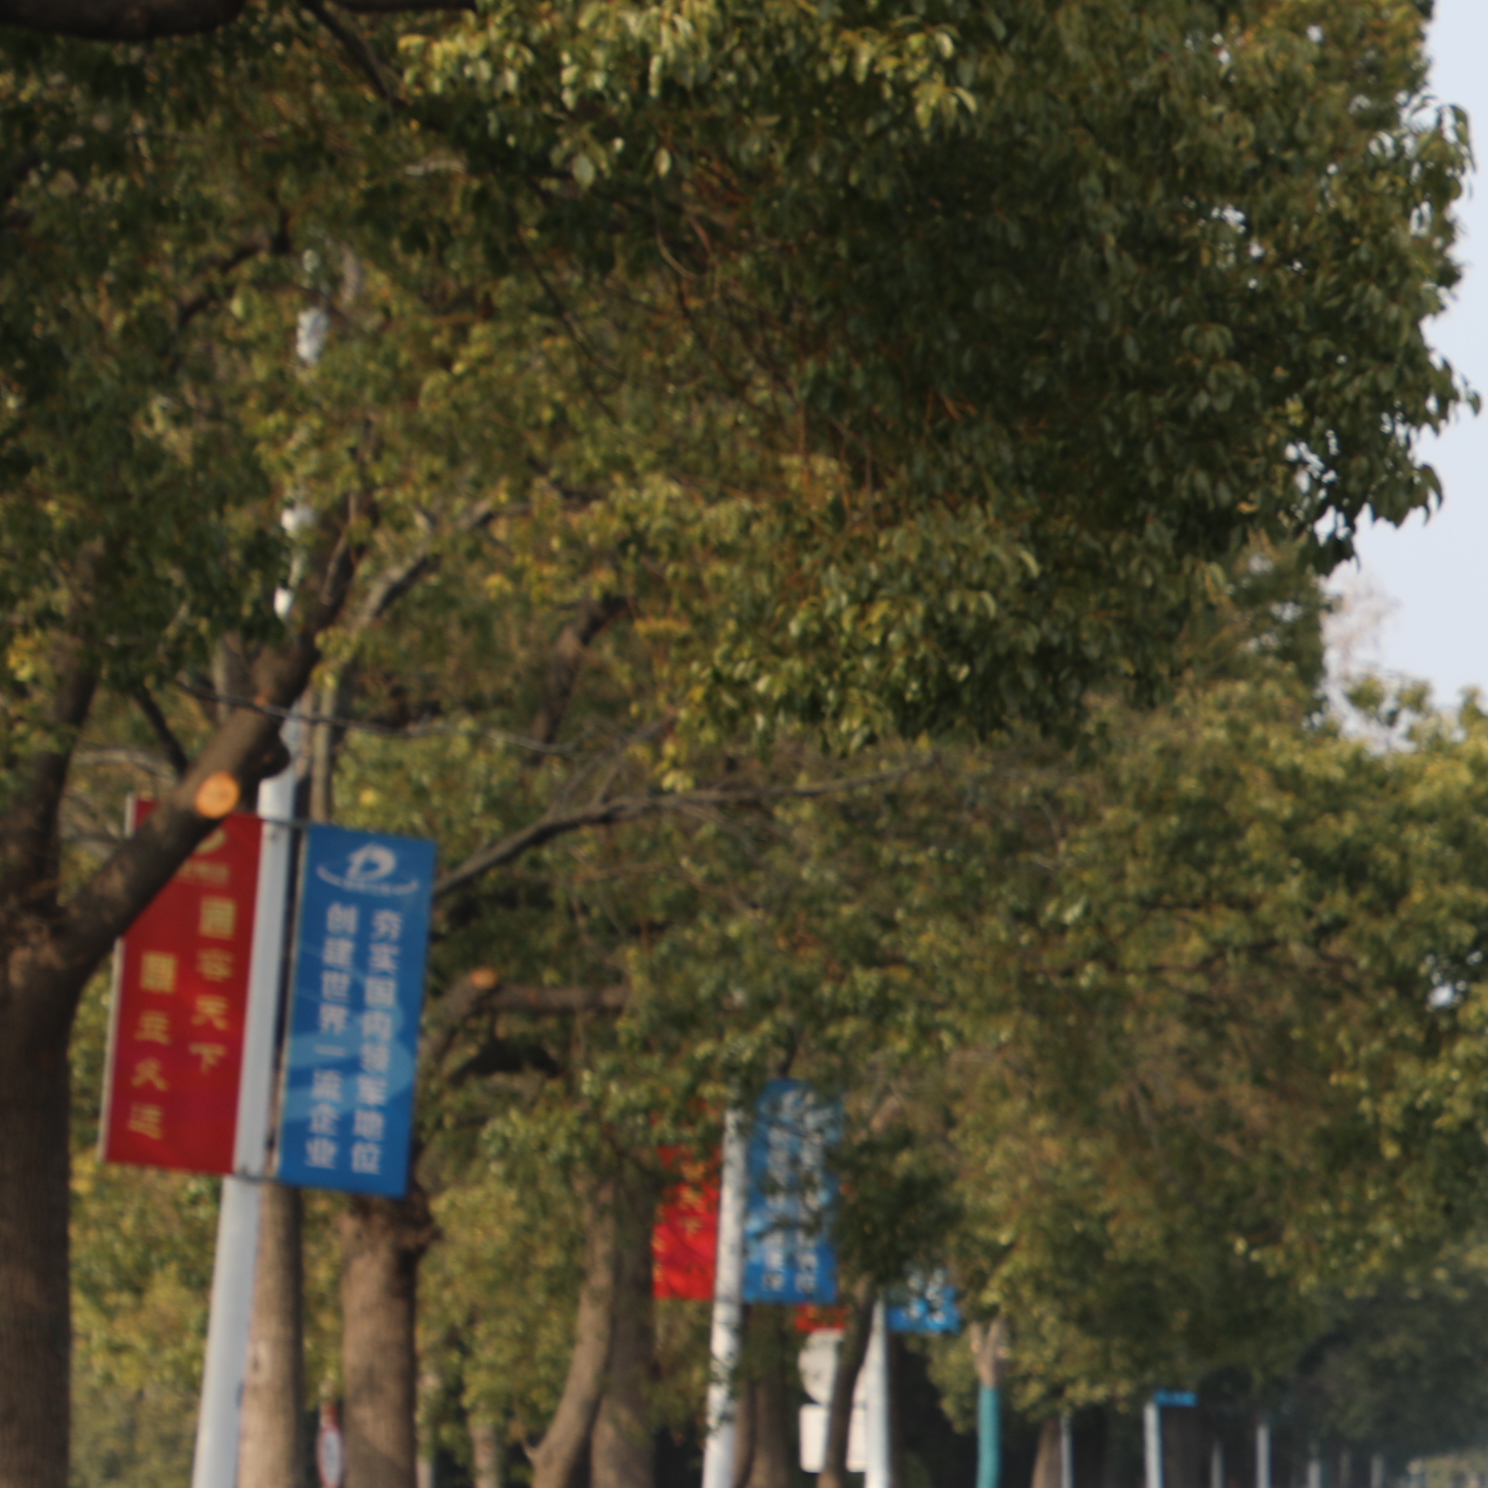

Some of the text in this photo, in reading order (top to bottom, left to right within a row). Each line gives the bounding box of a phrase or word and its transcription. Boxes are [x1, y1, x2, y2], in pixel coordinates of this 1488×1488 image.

[305, 902, 358, 1170] 创建世界一流企业
[352, 909, 402, 1175] 夯实国内领军地位
